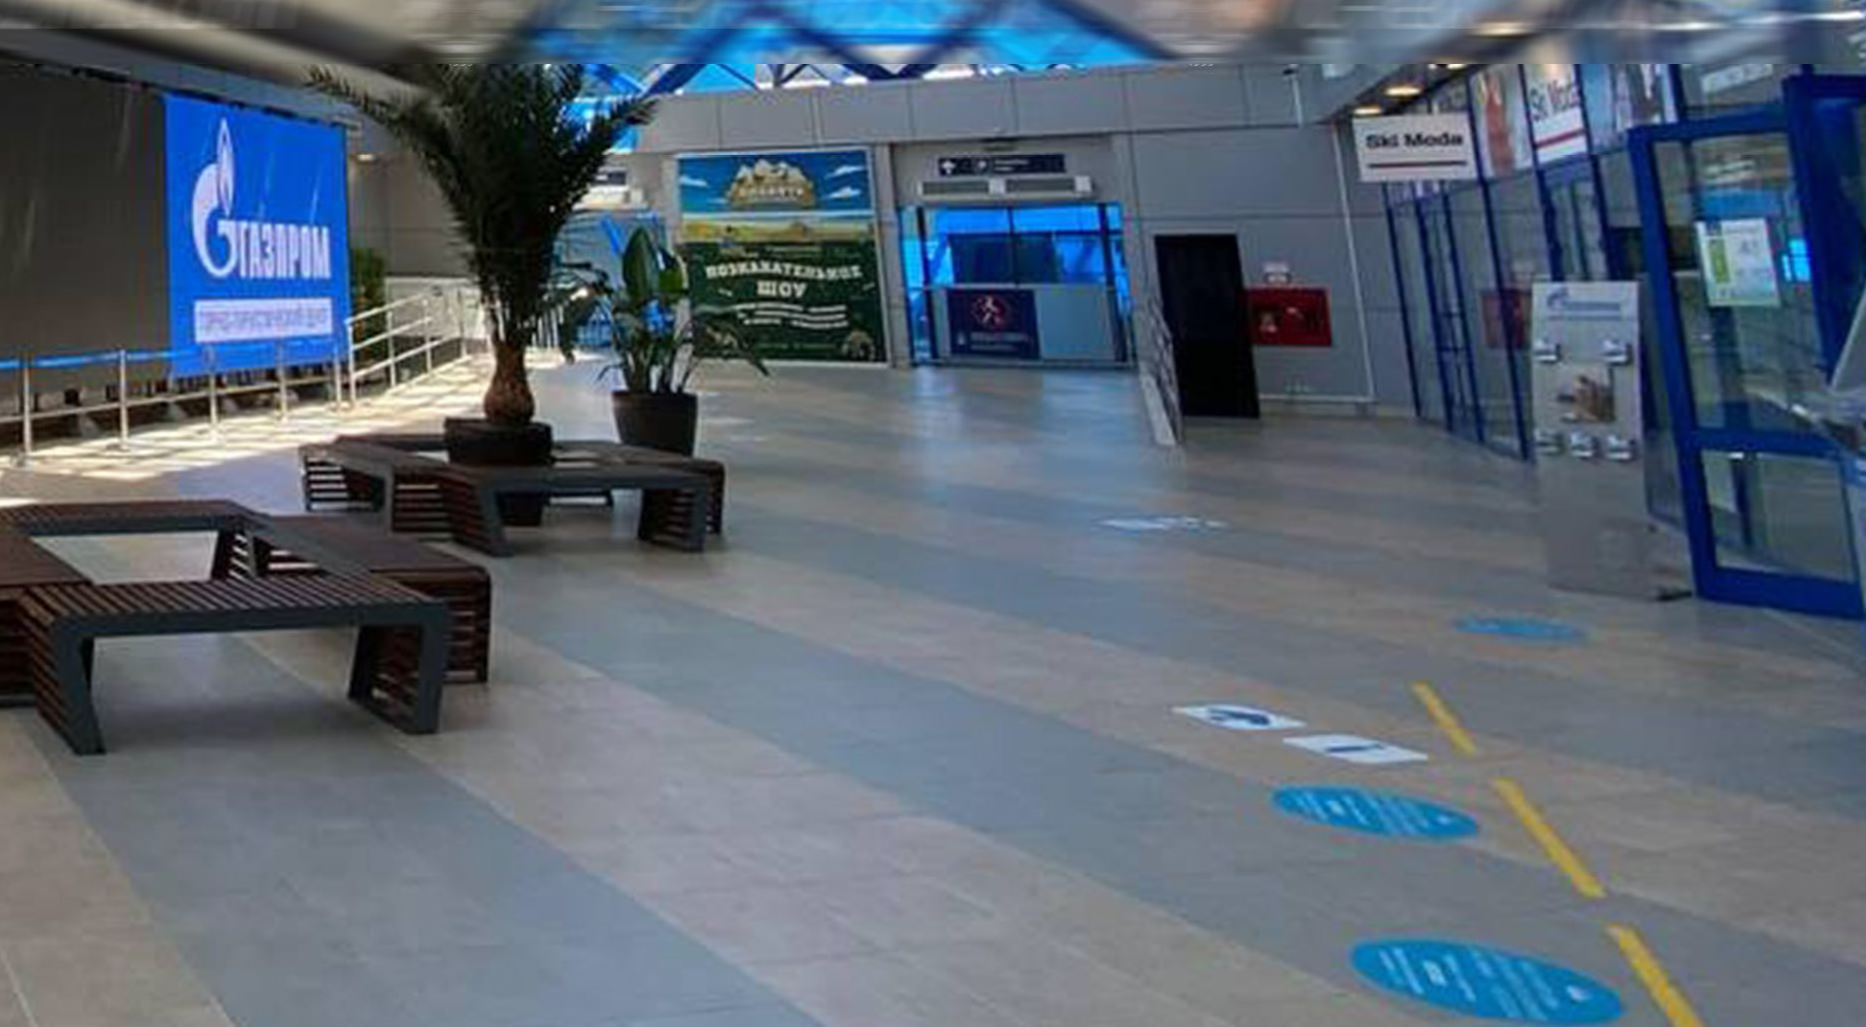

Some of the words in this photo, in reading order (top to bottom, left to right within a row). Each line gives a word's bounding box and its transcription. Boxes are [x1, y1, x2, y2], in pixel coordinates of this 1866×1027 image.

[1365, 133, 1399, 150] Ski
[1404, 131, 1463, 148] Moda
[239, 219, 332, 279] ГАЗПРОМ
[756, 280, 808, 298] ШОУ
